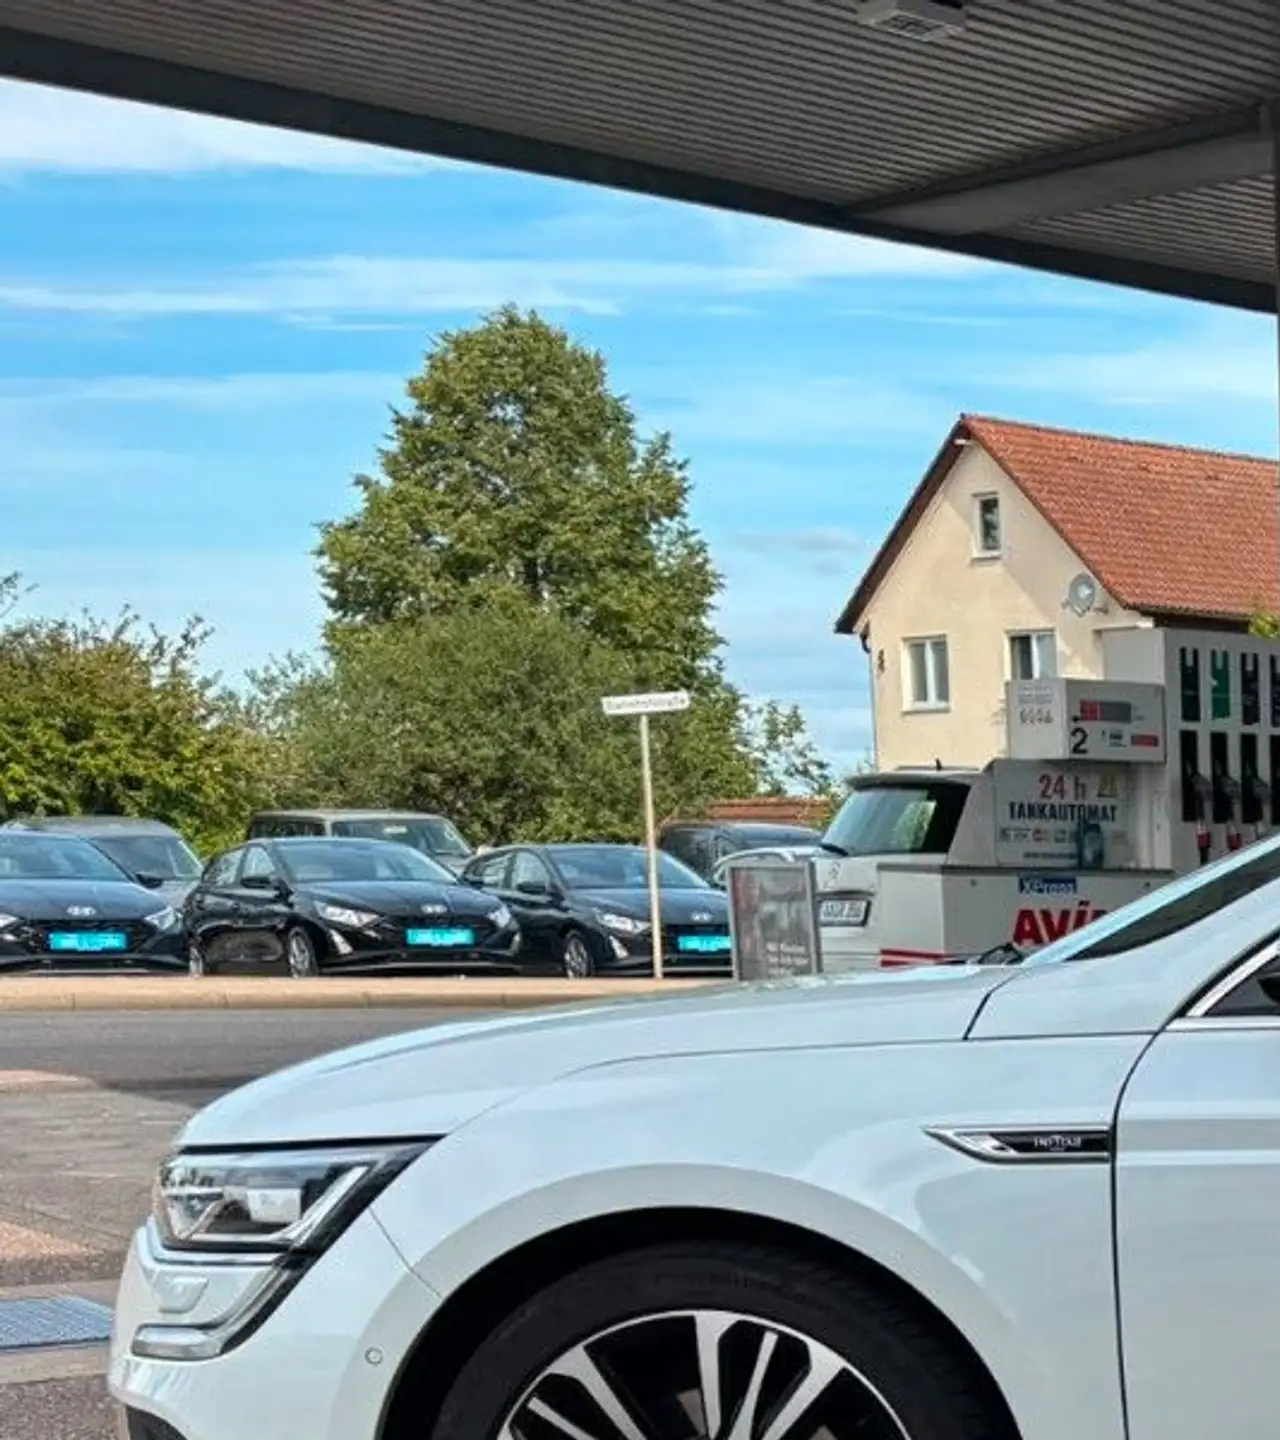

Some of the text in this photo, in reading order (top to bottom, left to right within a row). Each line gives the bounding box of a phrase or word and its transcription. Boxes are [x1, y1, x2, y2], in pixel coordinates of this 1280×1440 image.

[1070, 727, 1089, 754] 2
[1039, 773, 1066, 799] 24
[1074, 775, 1087, 800] h
[1008, 801, 1118, 823] TANKAUTOMAT
[1012, 900, 1108, 945] AVI
